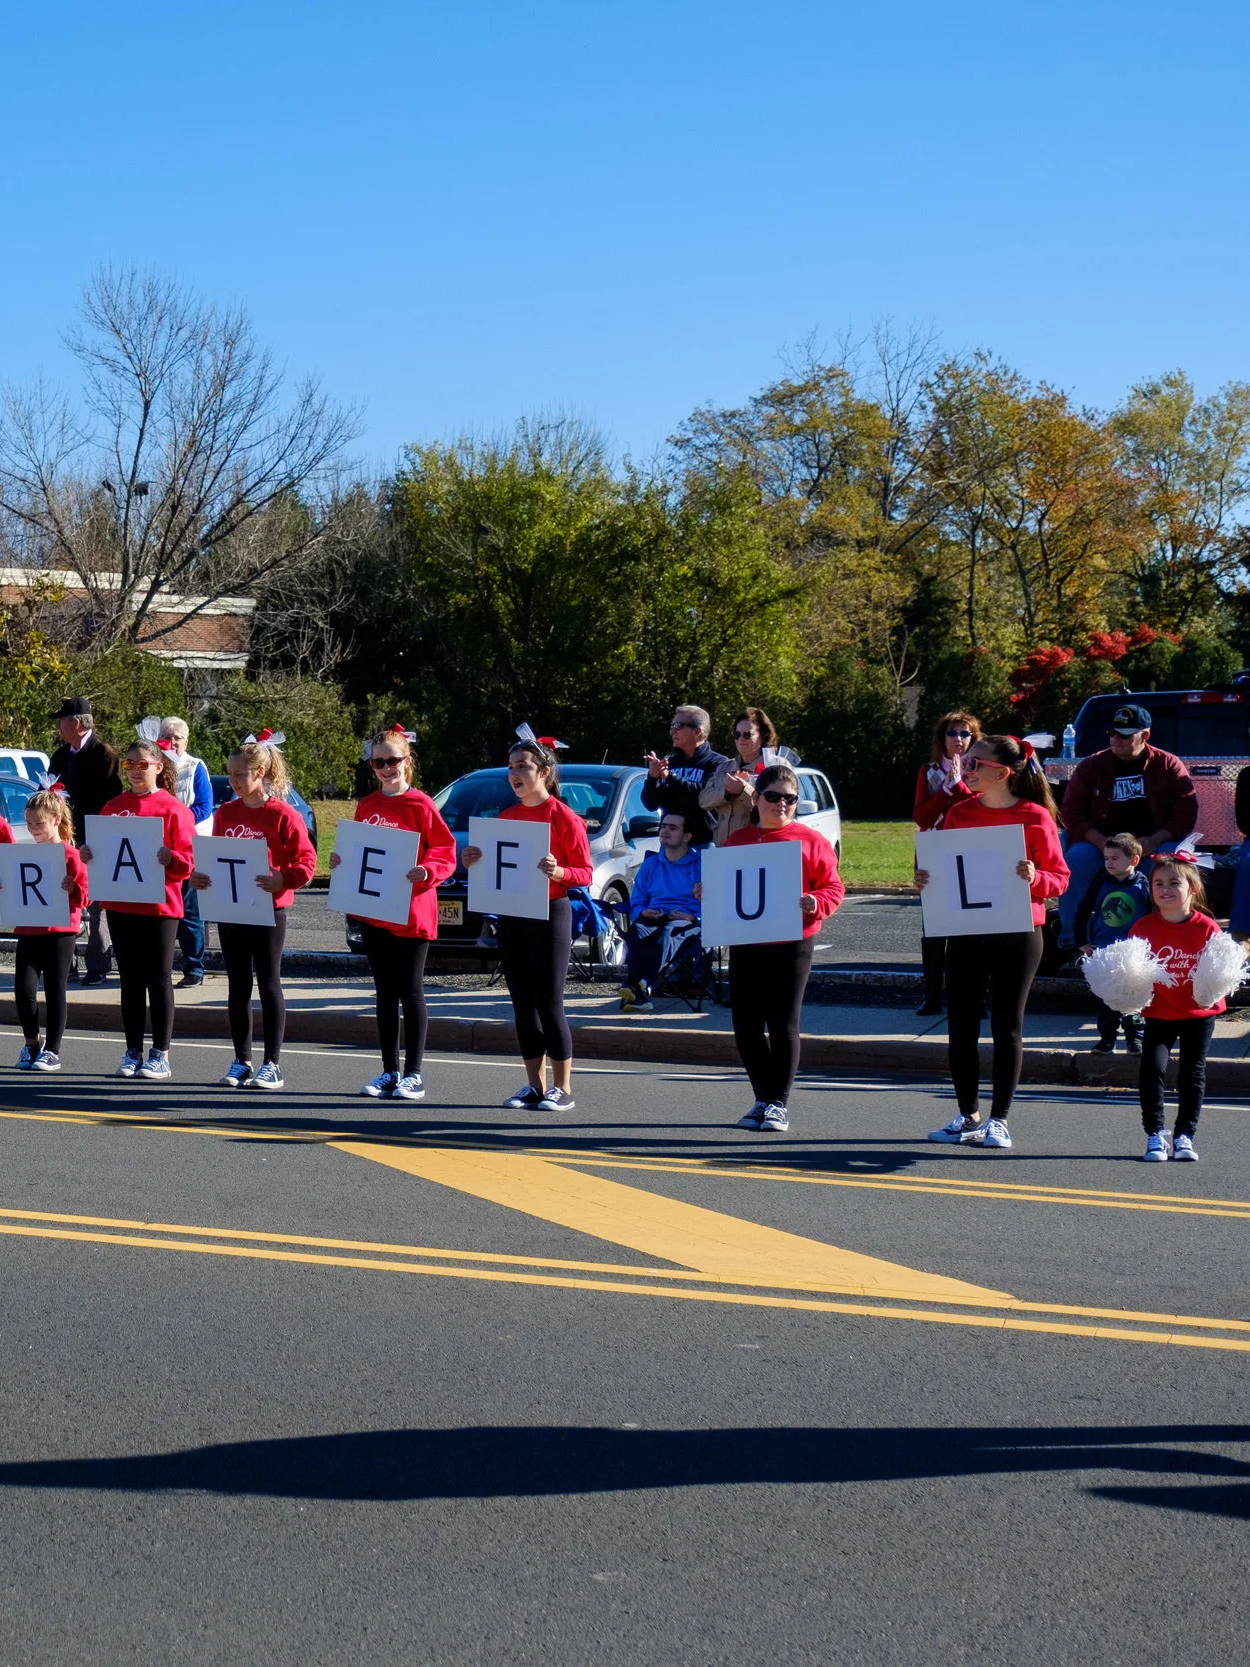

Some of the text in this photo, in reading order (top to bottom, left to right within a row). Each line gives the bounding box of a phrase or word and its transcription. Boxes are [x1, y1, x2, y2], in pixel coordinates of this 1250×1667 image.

[244, 827, 264, 837] Dance
[379, 816, 399, 828] Dance
[113, 837, 144, 883] A
[216, 857, 247, 904] T
[357, 846, 386, 898] E
[495, 840, 520, 891] F
[955, 854, 993, 910] L
[19, 862, 49, 906] R
[735, 867, 766, 921] U
[1170, 959, 1190, 969] with
